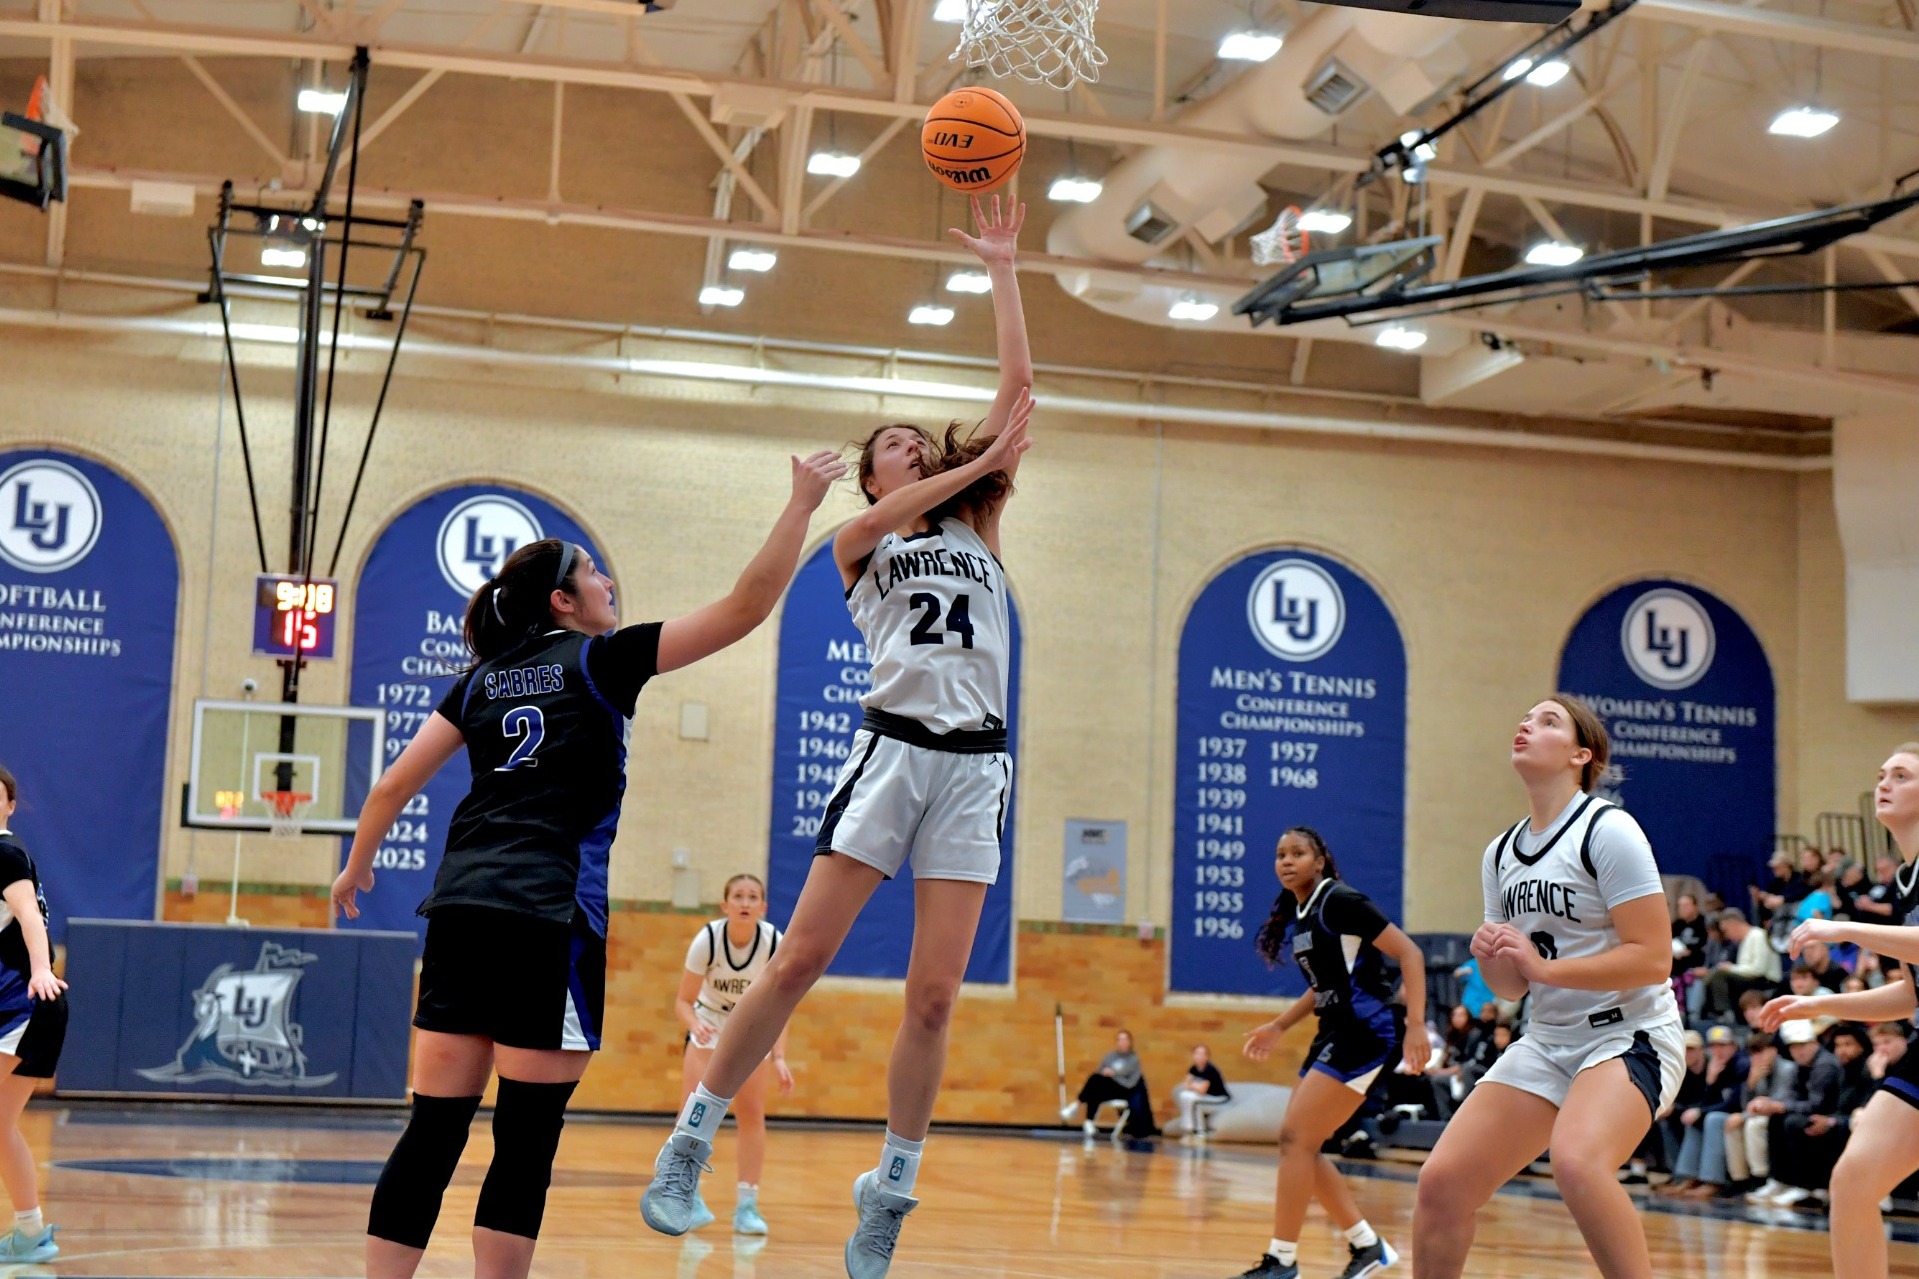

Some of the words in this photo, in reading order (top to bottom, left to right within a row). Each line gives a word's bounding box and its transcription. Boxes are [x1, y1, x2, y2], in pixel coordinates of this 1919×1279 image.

[928, 160, 992, 183] Wilson
[873, 549, 994, 601] LAWRENCE
[0, 612, 104, 636] NFERENCE
[909, 592, 975, 650] 24
[484, 664, 564, 699] SABRES
[840, 666, 871, 686] CO
[1210, 665, 1283, 693] MEN'S
[1287, 670, 1377, 699] TENNIS
[376, 683, 432, 708] 1972
[1235, 693, 1349, 719] CONFERENCE
[799, 710, 851, 733] 1942
[1220, 710, 1365, 738] CHAMPIONSHIPS
[1681, 701, 1758, 727] TENNIS
[494, 705, 545, 771] 2
[1614, 720, 1722, 745] CONFERENCE
[798, 736, 850, 759] 1946
[1198, 736, 1247, 759] 1937
[1270, 741, 1319, 763] 1957
[1198, 762, 1247, 784] 1938
[1270, 766, 1319, 789] 1968
[1197, 788, 1247, 810] 1939
[1197, 813, 1244, 835] 1941
[1196, 839, 1246, 860] 1949
[1195, 865, 1245, 888] 1953
[1195, 890, 1244, 913] 1955
[1502, 879, 1581, 923] WRENCE
[1194, 917, 1244, 940] 1956
[713, 978, 751, 994] AWRE
